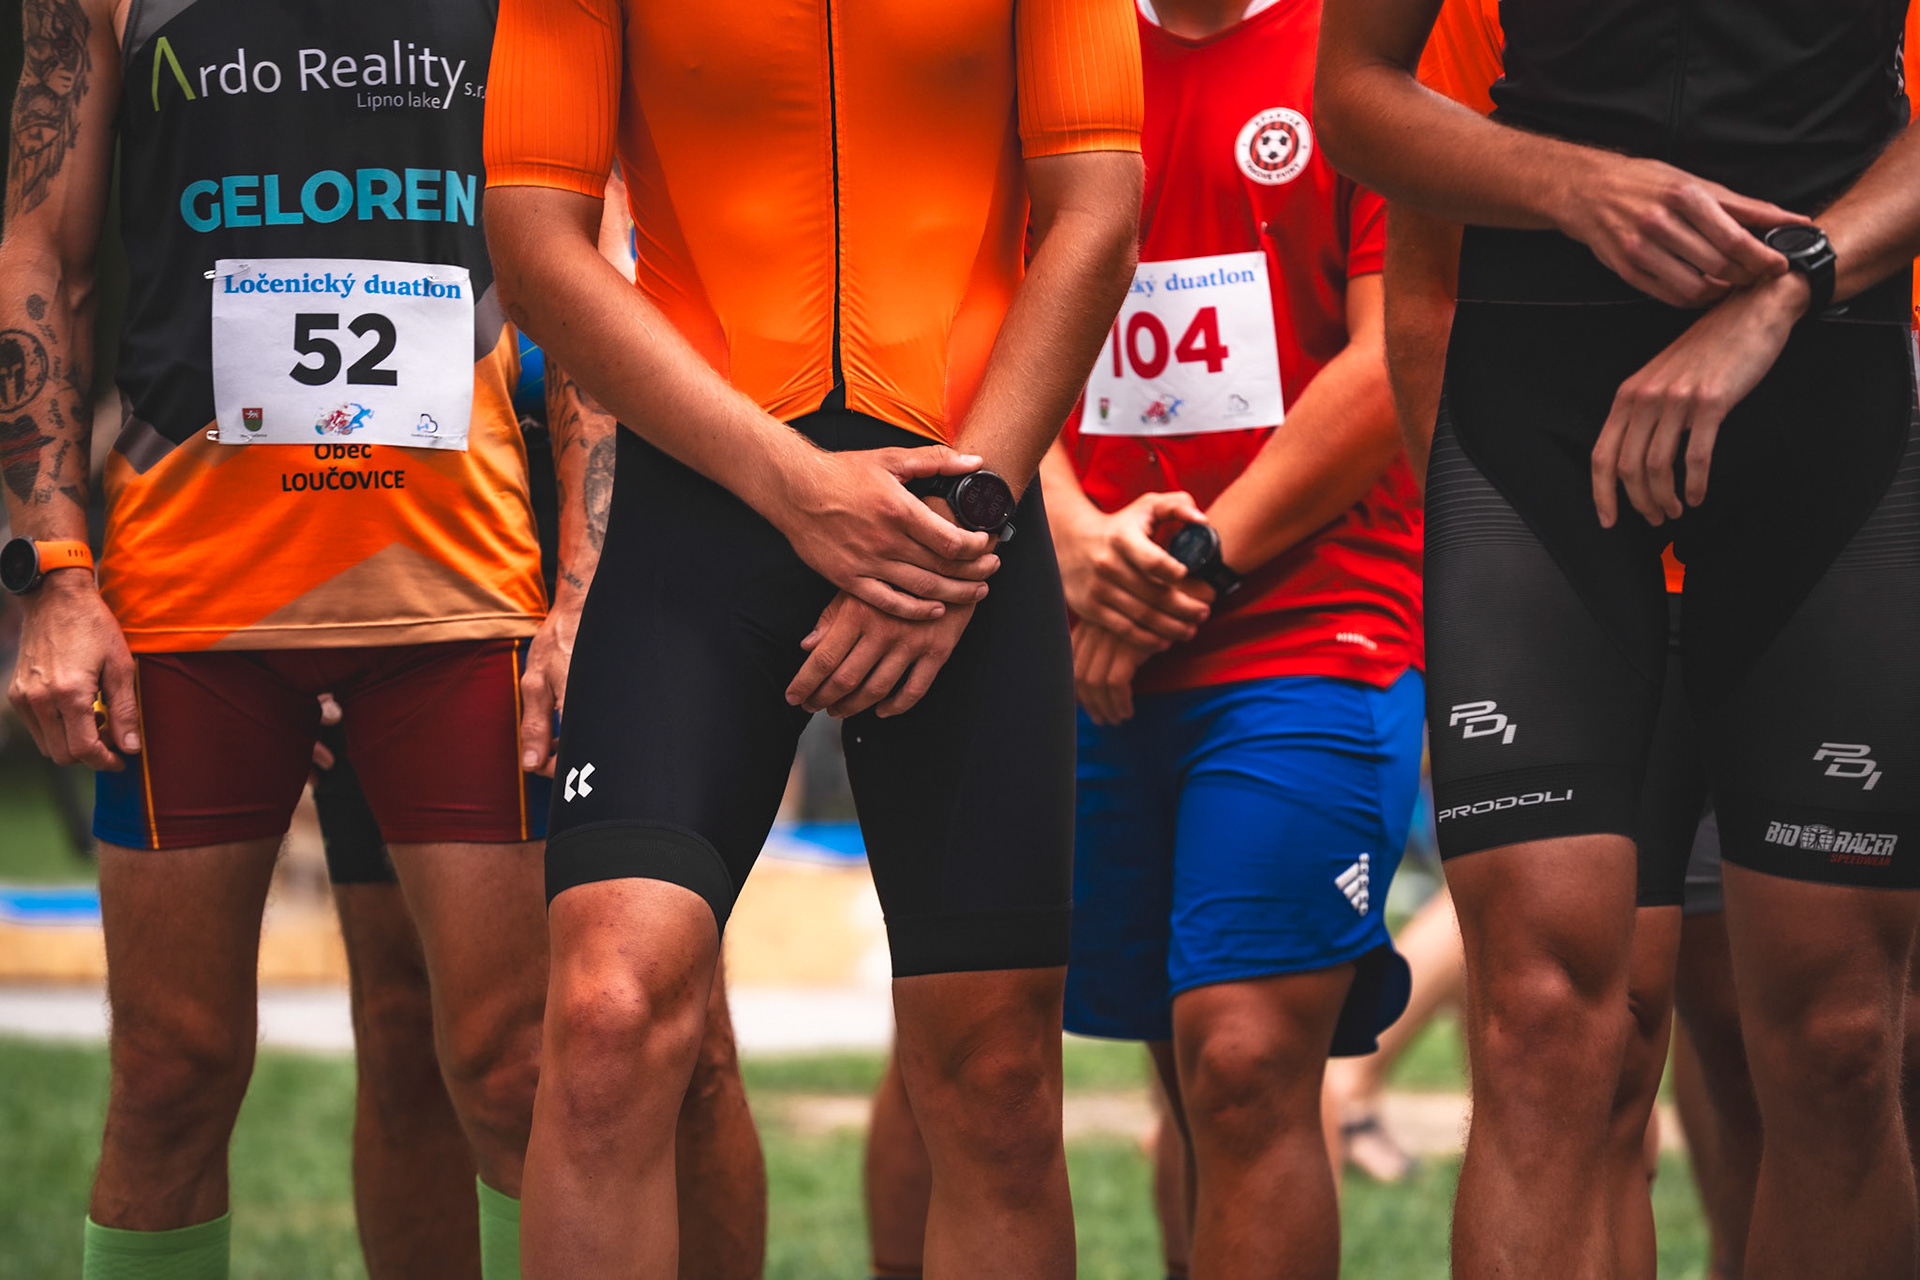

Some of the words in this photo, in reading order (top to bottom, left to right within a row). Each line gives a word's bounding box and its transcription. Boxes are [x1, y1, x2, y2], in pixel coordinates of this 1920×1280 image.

[152, 36, 282, 112] Ardo
[298, 40, 466, 110] Reality
[356, 92, 405, 112] Lipno
[407, 90, 441, 110] lake
[180, 168, 477, 233] GELOREN
[223, 272, 357, 299] Ločenický
[364, 274, 462, 300] duatlon
[1164, 267, 1256, 292] duatlon
[289, 312, 399, 387] 52
[1111, 306, 1230, 380] 104
[314, 443, 373, 460] Obec
[281, 466, 406, 492] LOUČOVICE
[1449, 700, 1517, 744] PDI
[1812, 742, 1883, 790] PDI
[1438, 789, 1573, 823] PRODOLI
[1832, 831, 1899, 856] RACER
